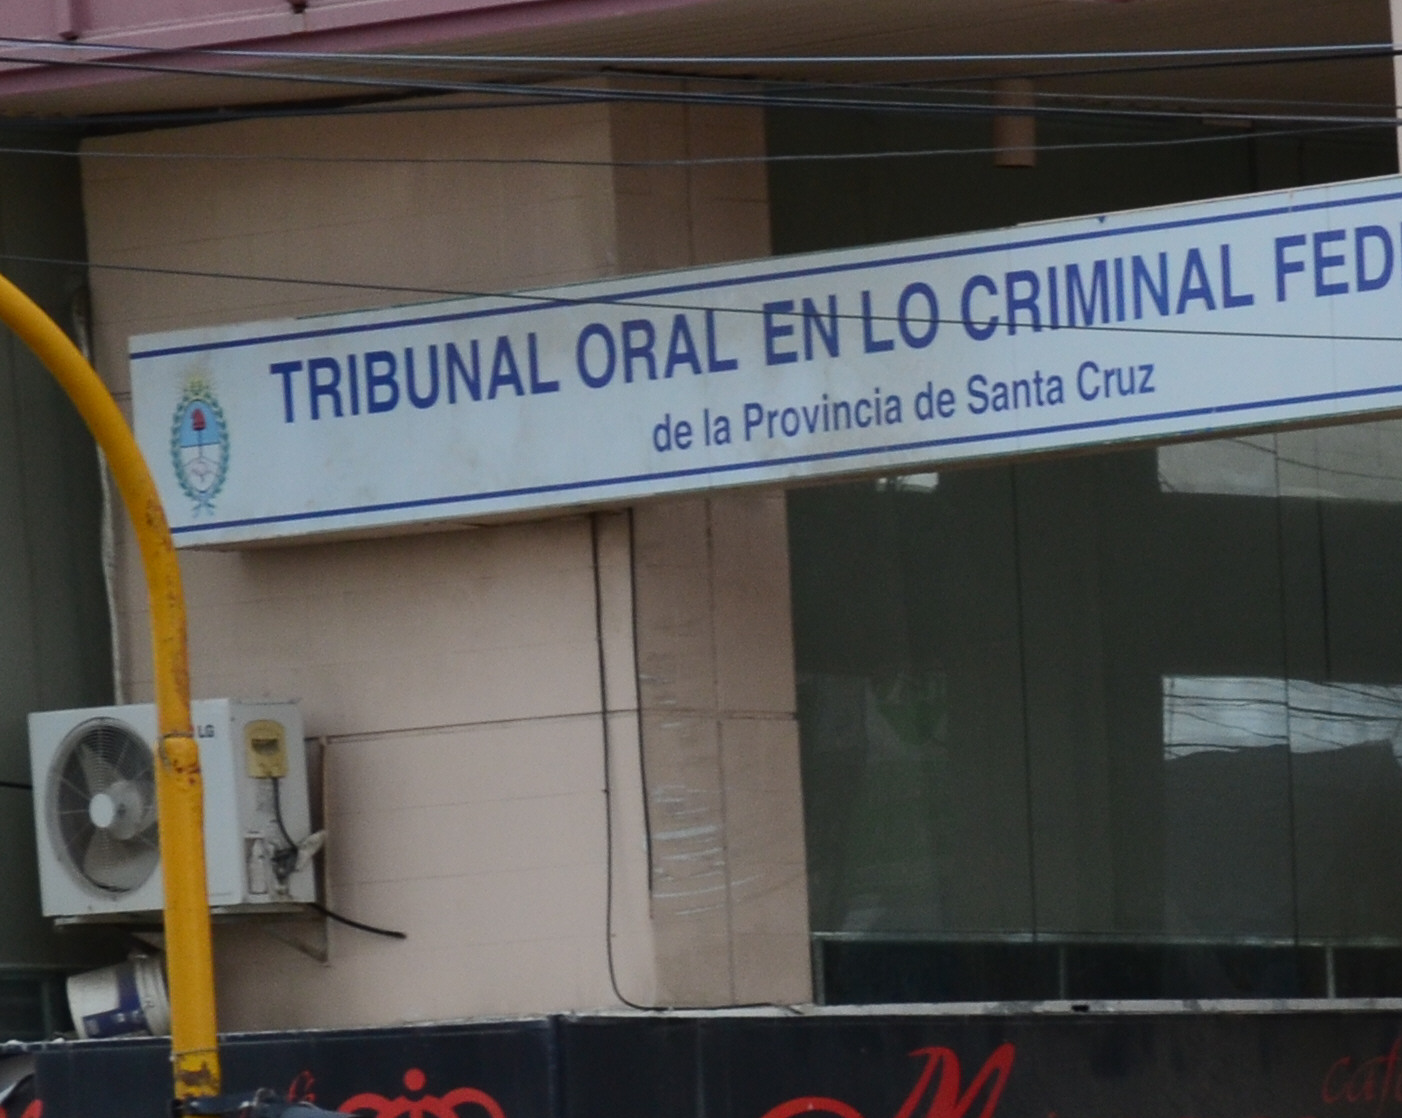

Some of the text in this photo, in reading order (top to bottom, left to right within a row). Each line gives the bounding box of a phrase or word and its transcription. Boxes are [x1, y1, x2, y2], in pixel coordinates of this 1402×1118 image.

[270, 333, 560, 424] TRIBUNAL
[576, 308, 739, 389] ORAL
[763, 290, 841, 366] EN
[863, 281, 941, 354] LO
[961, 245, 1256, 342] CRIMINAL
[652, 360, 1157, 454] de la Provincia de Santa Cruz
[198, 724, 215, 738] LG
